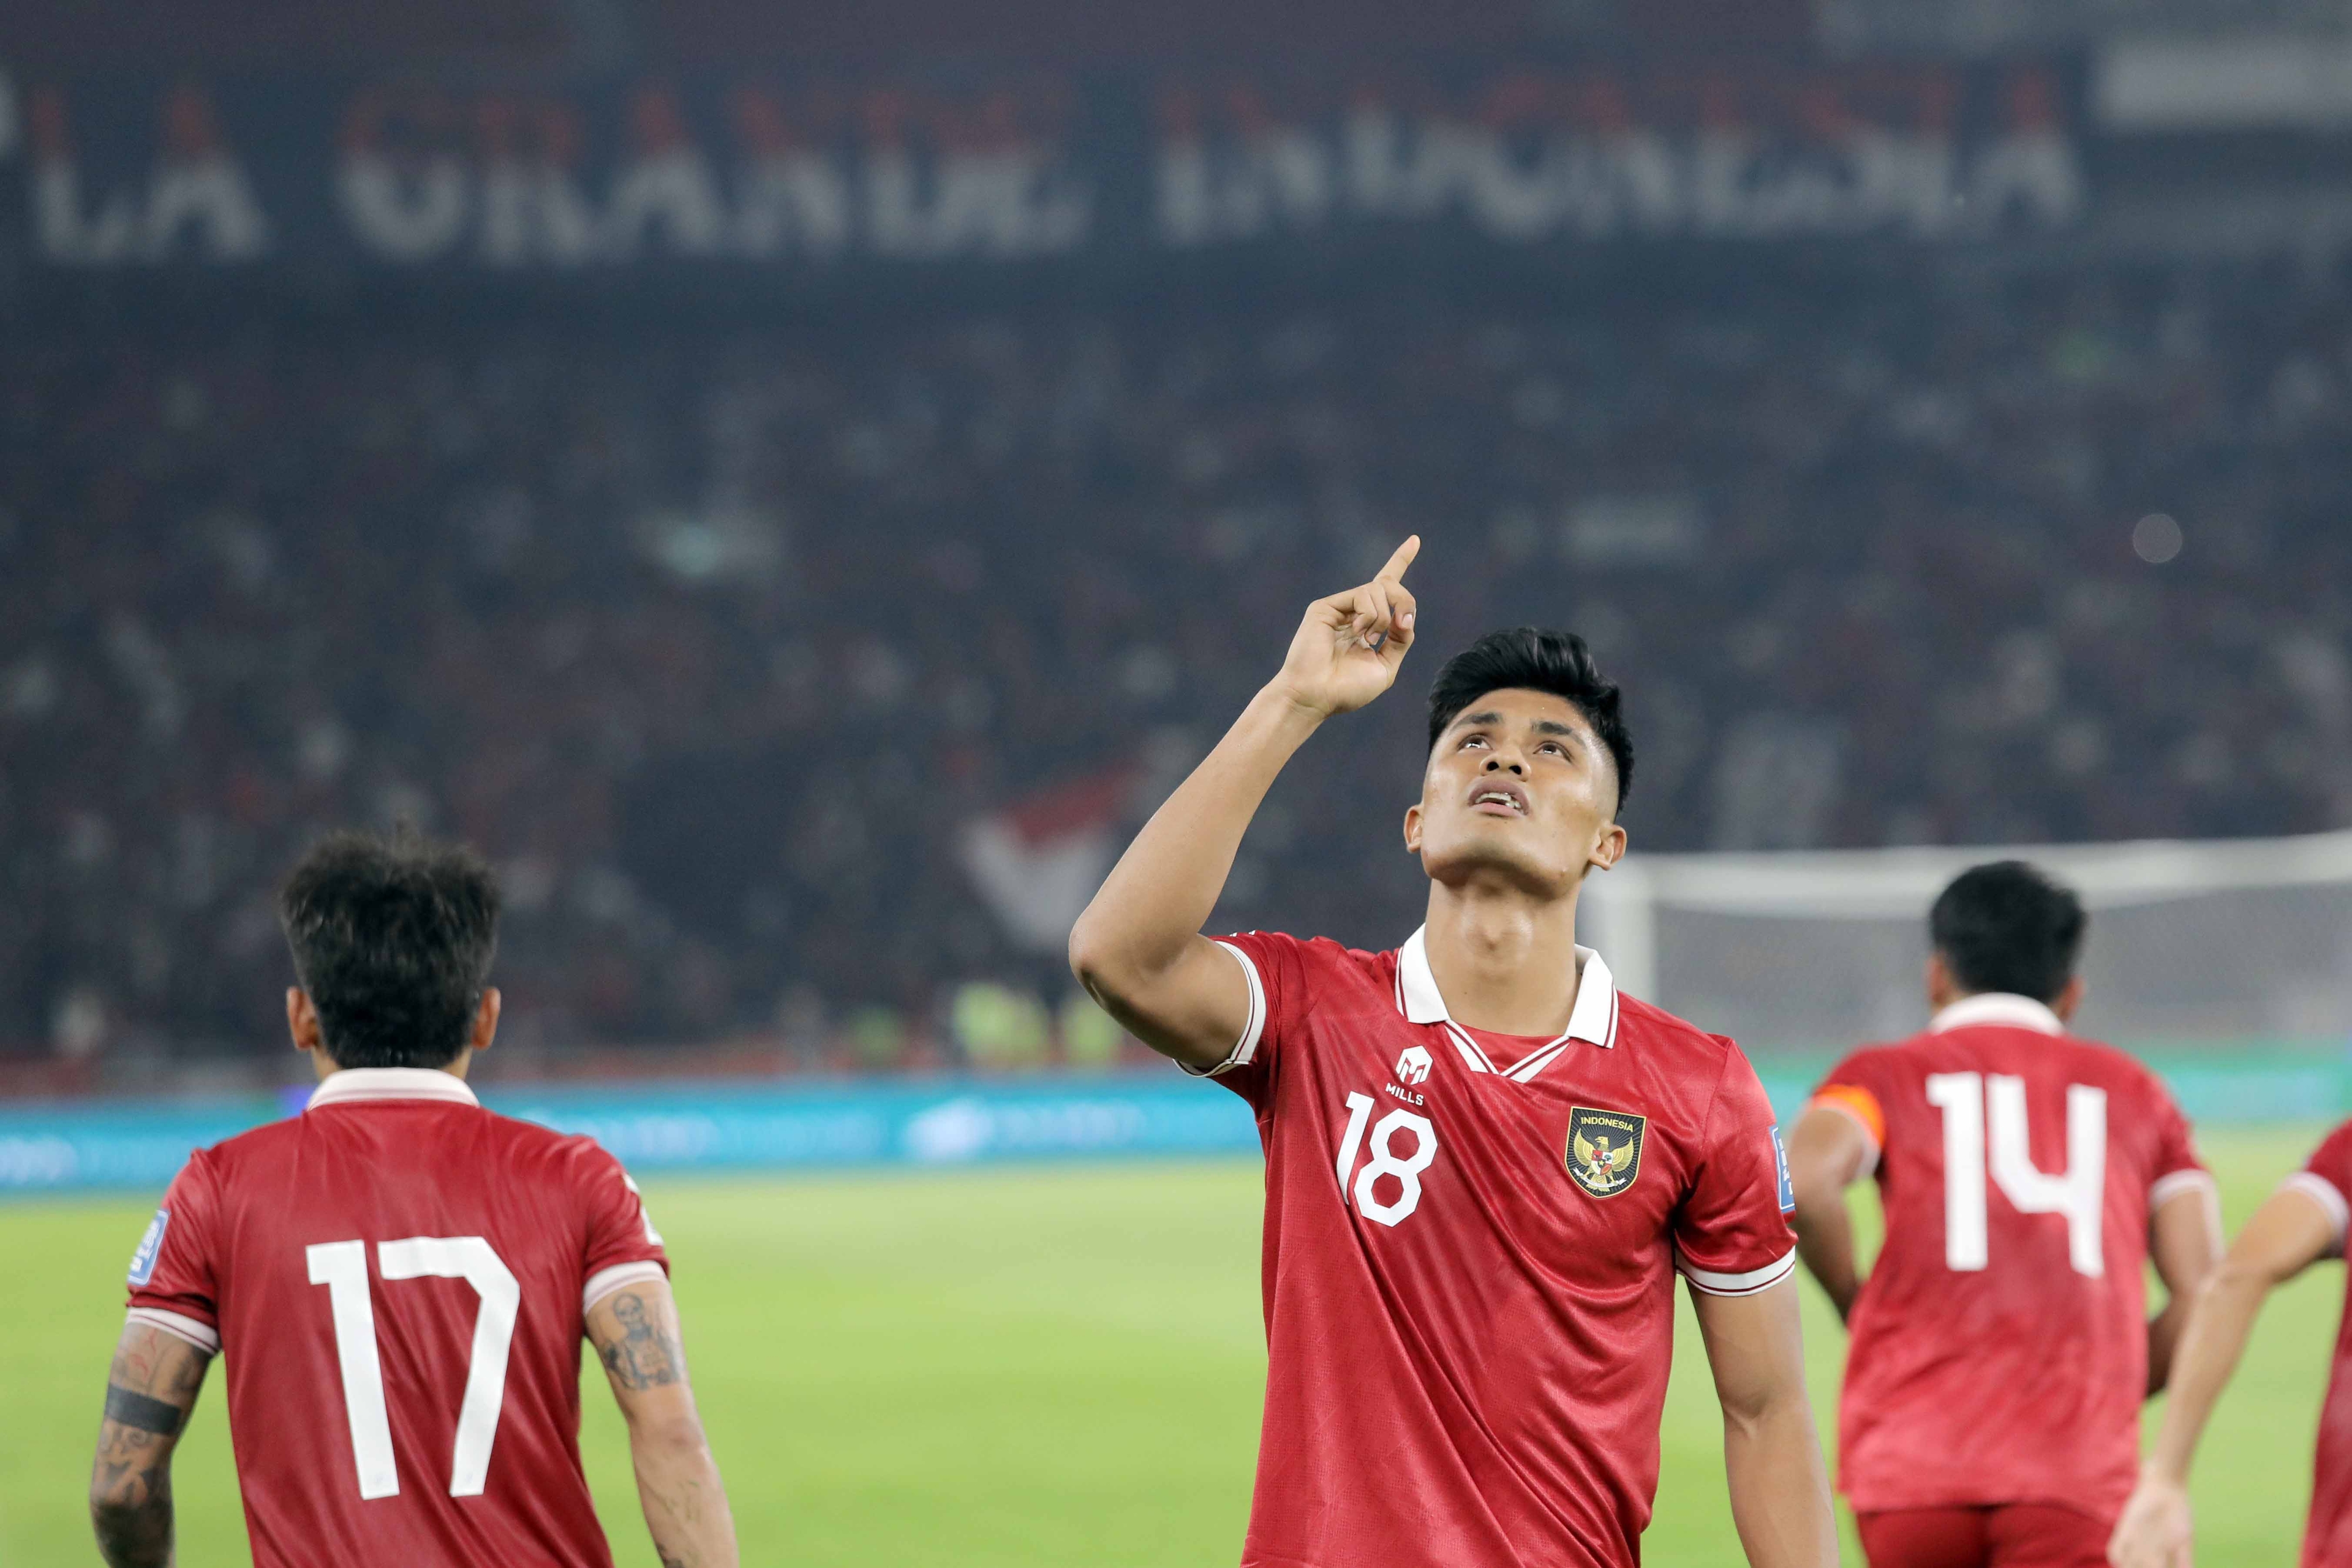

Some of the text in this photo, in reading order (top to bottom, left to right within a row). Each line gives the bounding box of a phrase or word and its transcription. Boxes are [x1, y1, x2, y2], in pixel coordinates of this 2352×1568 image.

[31, 77, 270, 263] LA
[1336, 1091, 1438, 1227] 18
[1385, 1082, 1424, 1106] MILLS
[1580, 1116, 1634, 1133] INDONESIA
[1926, 1072, 2107, 1278] 14
[306, 1237, 520, 1500] 17
